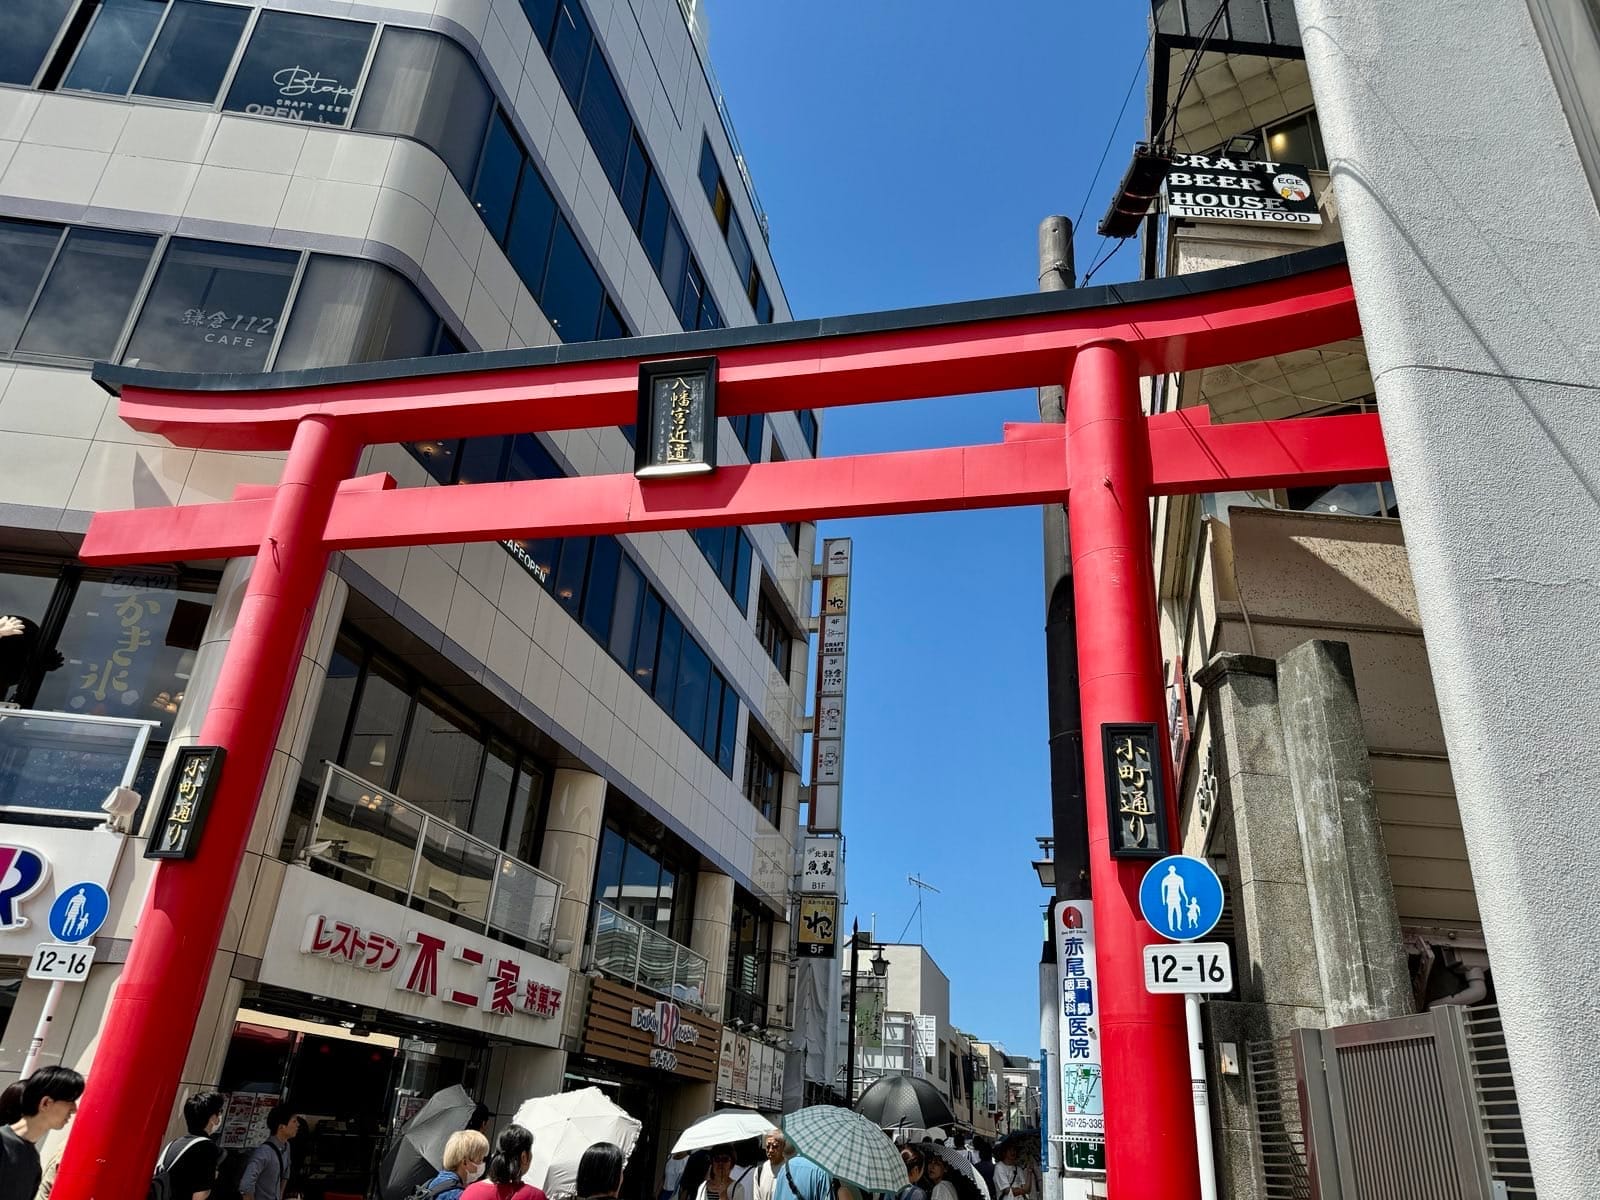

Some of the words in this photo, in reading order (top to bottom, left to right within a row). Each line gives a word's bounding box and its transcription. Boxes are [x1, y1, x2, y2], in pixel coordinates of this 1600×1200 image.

[245, 103, 304, 120] OPEN
[276, 98, 313, 109] CRAFT
[1171, 154, 1280, 174] CRAFT
[1169, 172, 1265, 191] BEER
[1277, 177, 1303, 186] EGE
[1171, 191, 1288, 211] HOUSE
[1180, 206, 1257, 220] TURKISH
[1261, 211, 1311, 223] FOOD
[182, 308, 278, 334] 鎌倉112
[204, 333, 256, 347] CAFE
[667, 377, 692, 462] 八幡宮近道
[80, 595, 160, 701] かき氷
[1115, 738, 1155, 843] 小町通り
[167, 758, 206, 847] 小町通り
[810, 944, 825, 954] 5F
[1065, 937, 1085, 977] 赤尾
[35, 951, 87, 975] 12-16
[309, 914, 401, 971] レストラン
[405, 931, 521, 1016] 不二家
[522, 979, 562, 1018] 洋菓子
[1152, 955, 1225, 983] 12-16
[1069, 1018, 1090, 1058] 医院
[1075, 1154, 1095, 1165] 1-5
